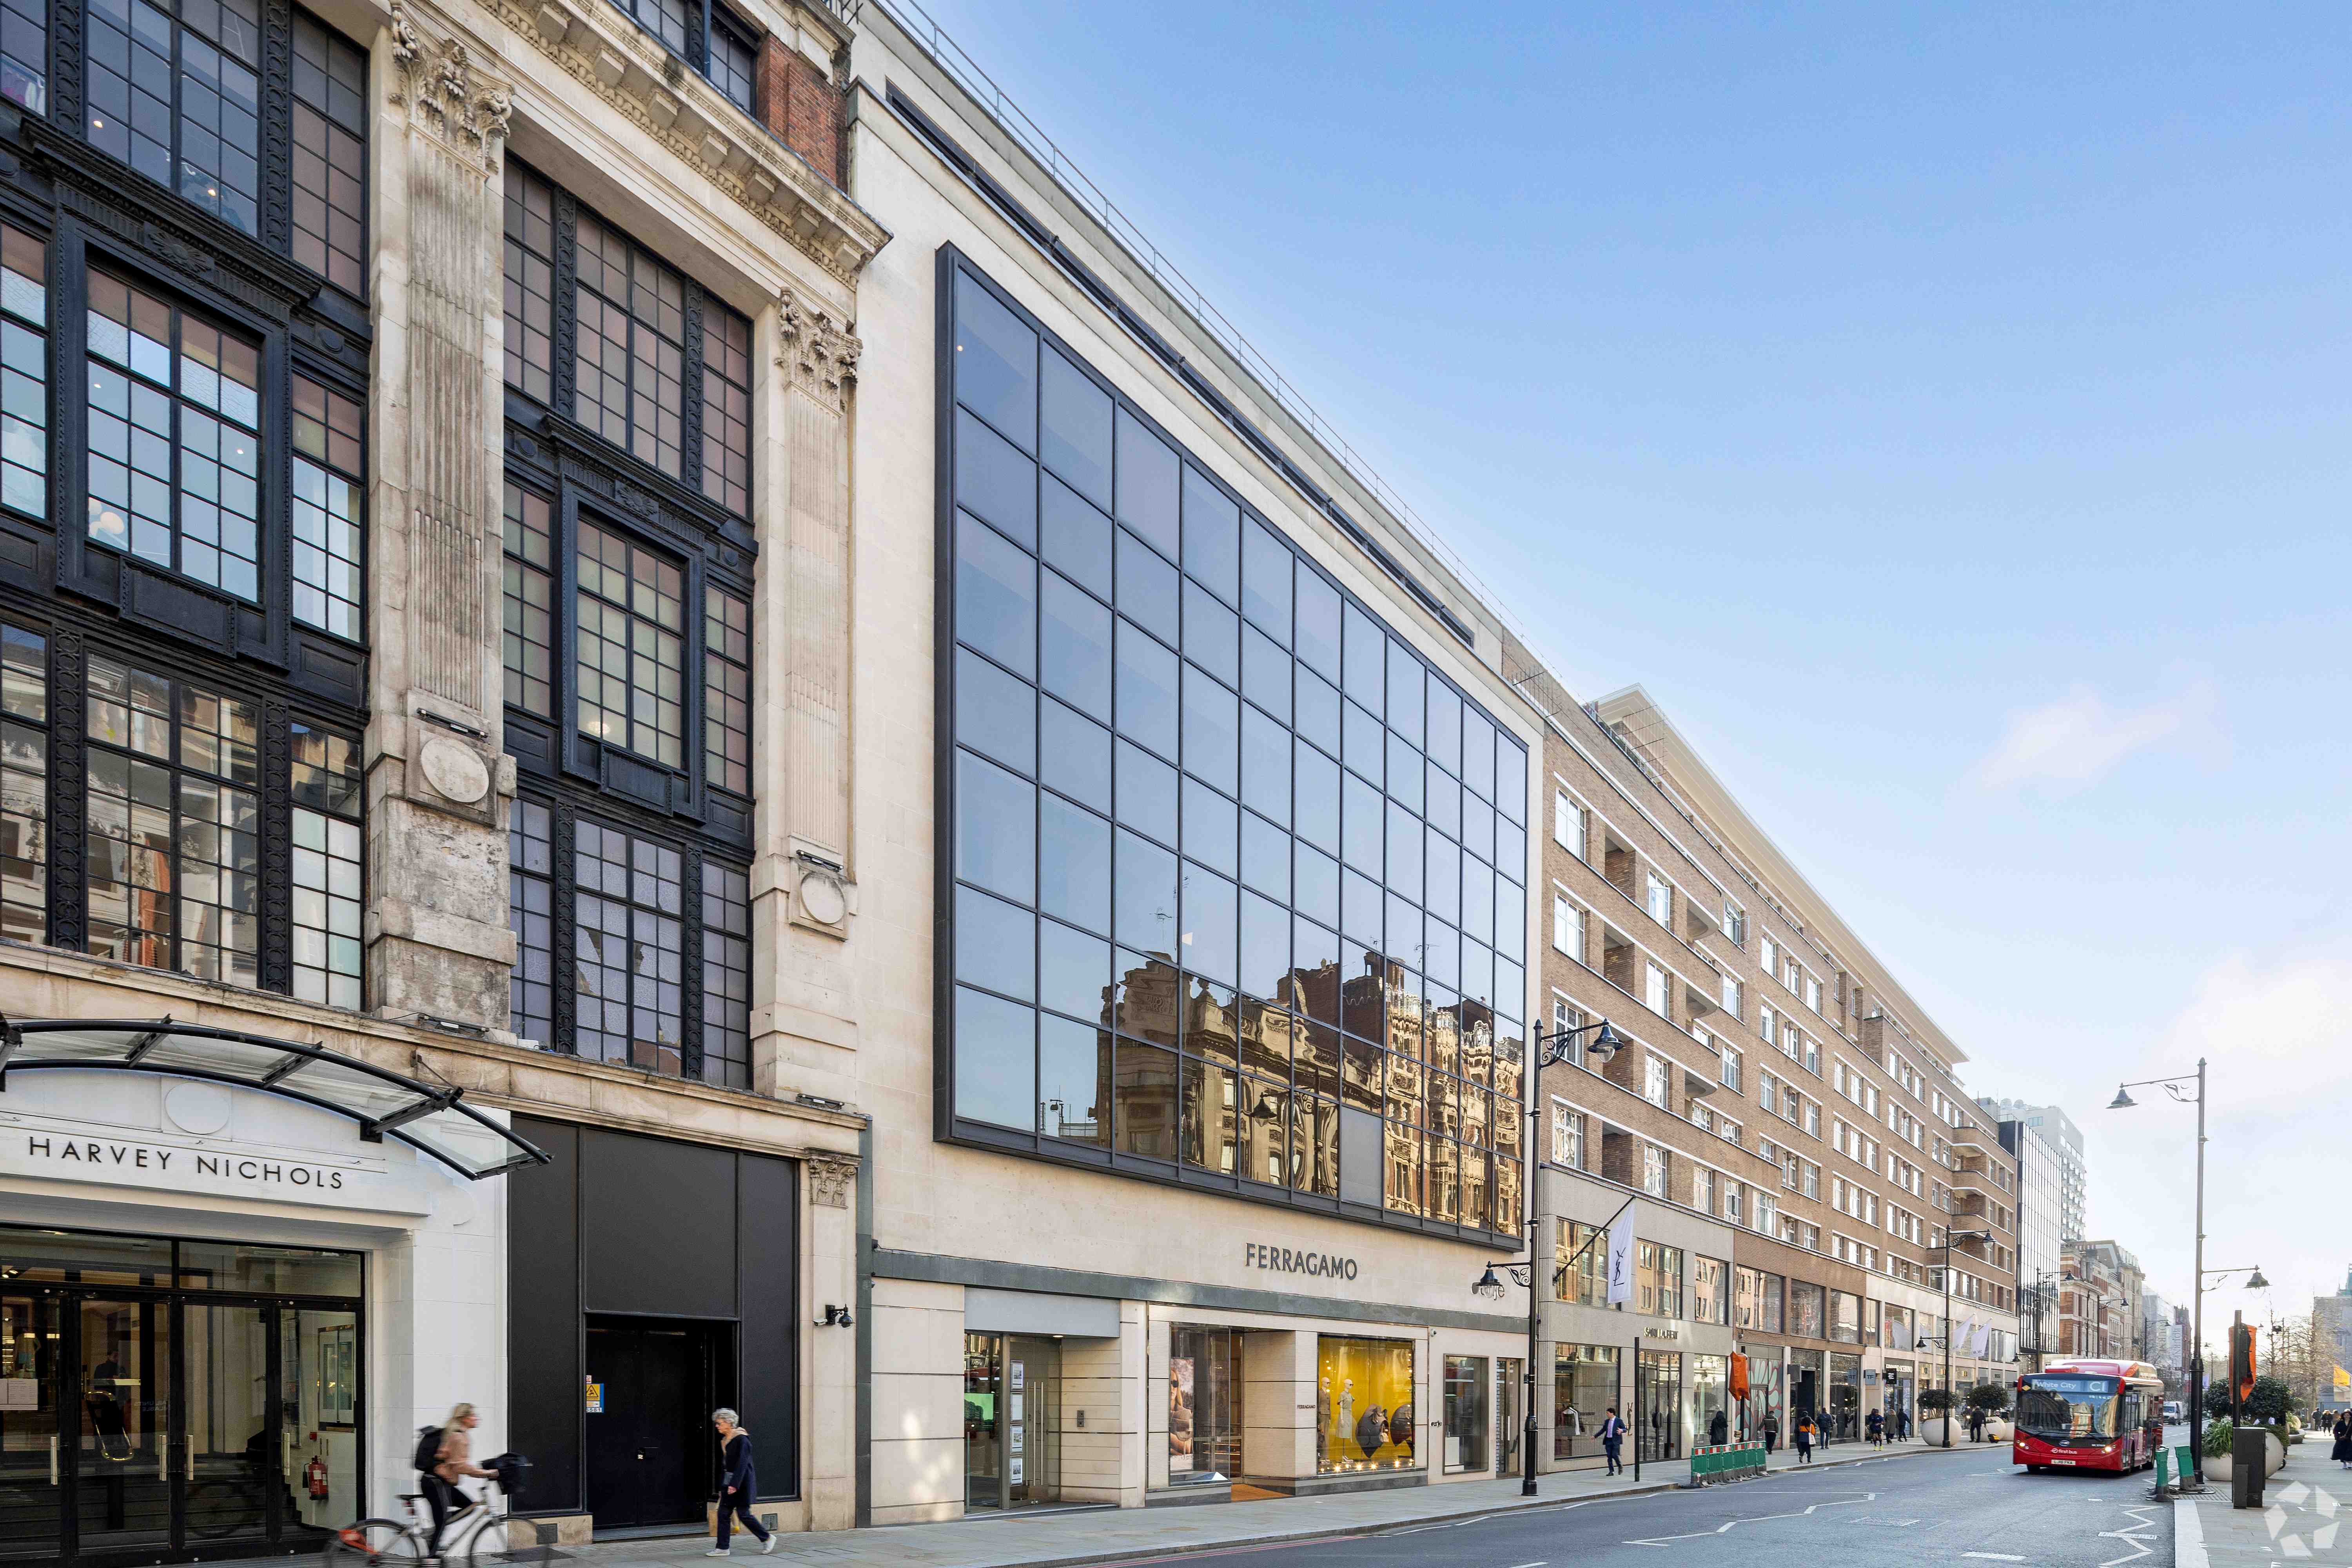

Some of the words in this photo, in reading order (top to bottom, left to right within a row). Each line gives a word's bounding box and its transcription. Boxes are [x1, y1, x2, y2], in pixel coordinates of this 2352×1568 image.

[29, 1136, 171, 1170] HARVEY
[198, 1155, 343, 1189] NICHOLS
[1245, 1243, 1357, 1280] FERRAGAMO
[1657, 1329, 1679, 1339] LAURENT
